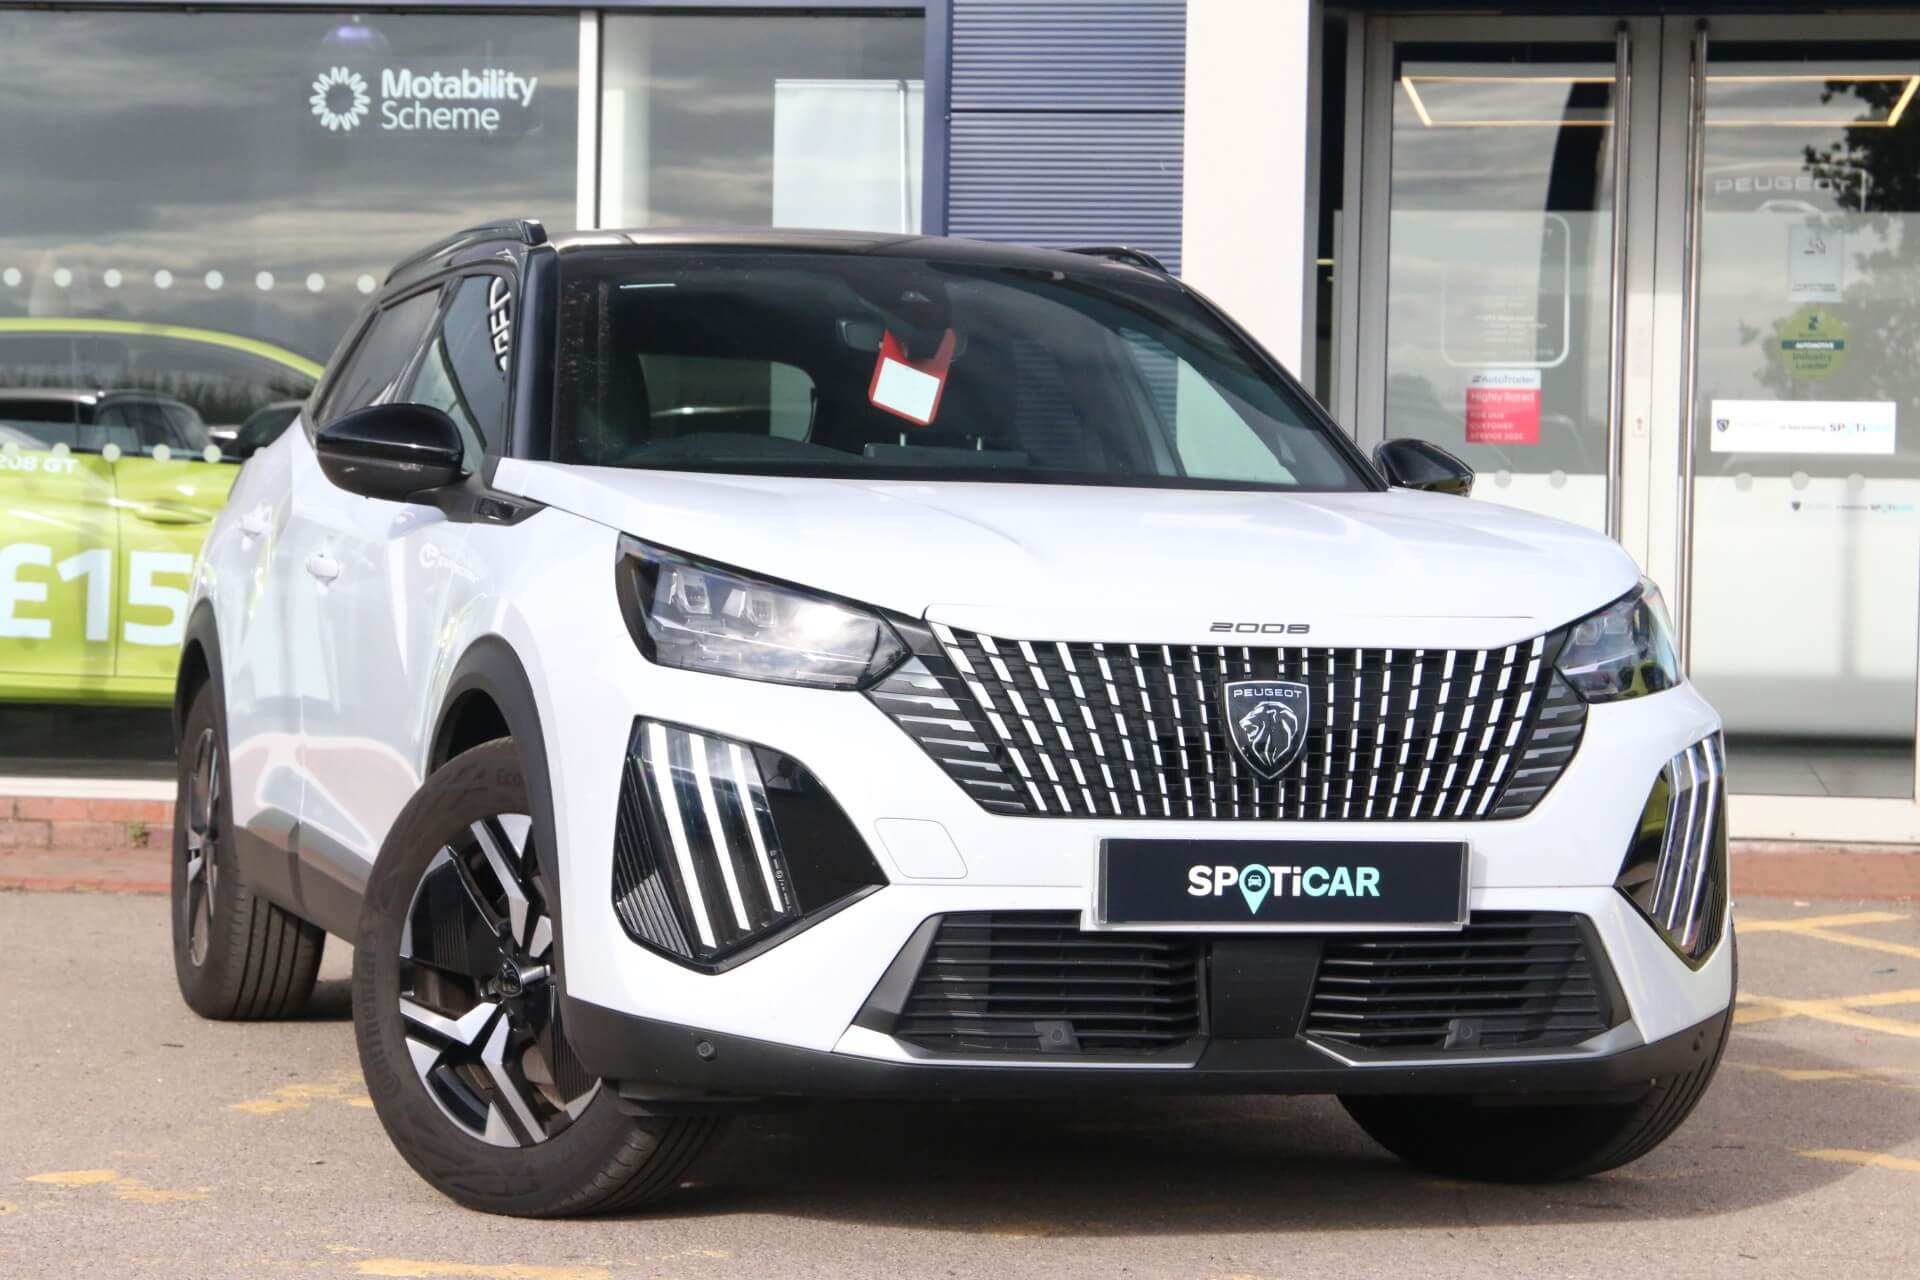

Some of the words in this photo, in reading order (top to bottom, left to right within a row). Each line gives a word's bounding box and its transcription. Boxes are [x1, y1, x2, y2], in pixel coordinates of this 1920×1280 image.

[381, 68, 539, 107] Motability
[381, 100, 500, 130] Scheme
[1714, 175, 1850, 193] PEUGEOT
[1209, 622, 1310, 634] 2008
[1233, 688, 1302, 698] PEUGEOT
